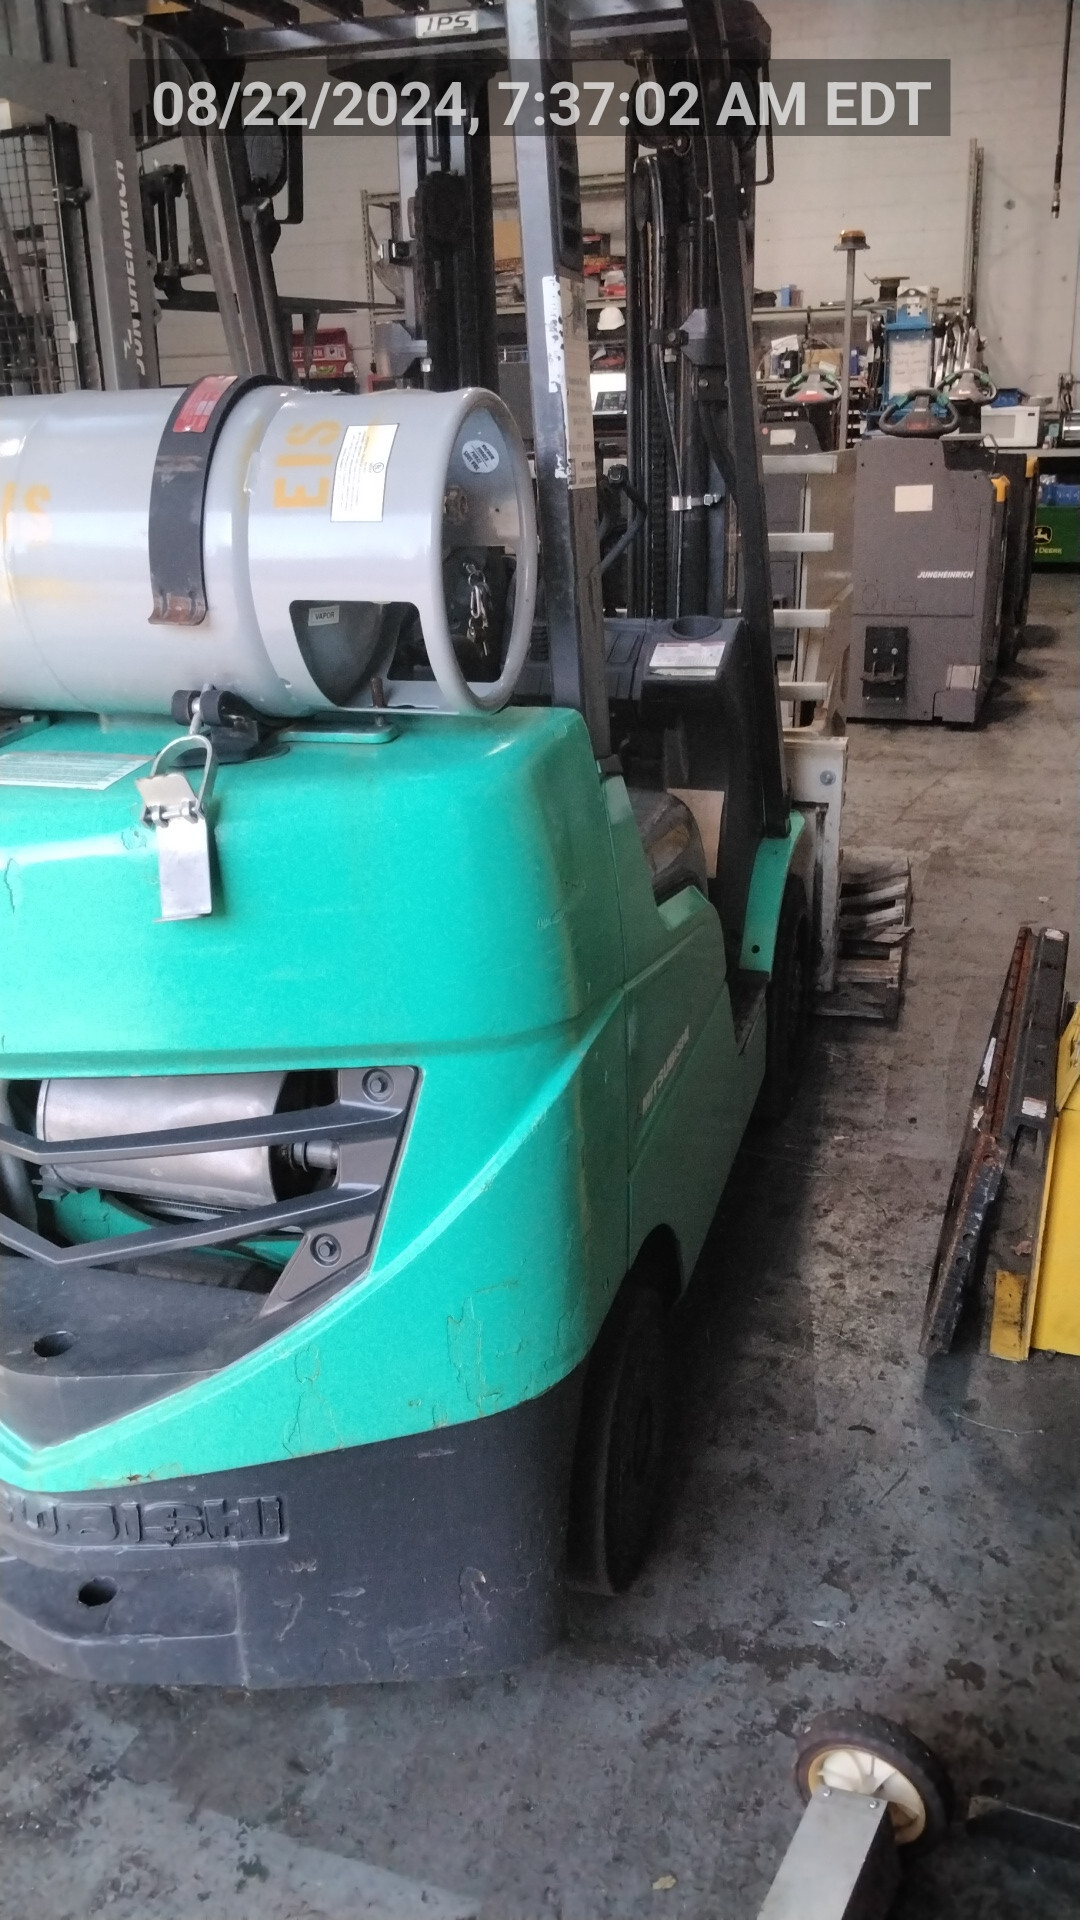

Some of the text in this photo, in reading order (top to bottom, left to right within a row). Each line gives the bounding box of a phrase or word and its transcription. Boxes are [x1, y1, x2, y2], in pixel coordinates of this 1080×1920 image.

[427, 15, 471, 32] IPS
[274, 420, 341, 508] EIS
[917, 570, 974, 579] JUNGHEINRICH
[315, 611, 335, 620] VAPOR
